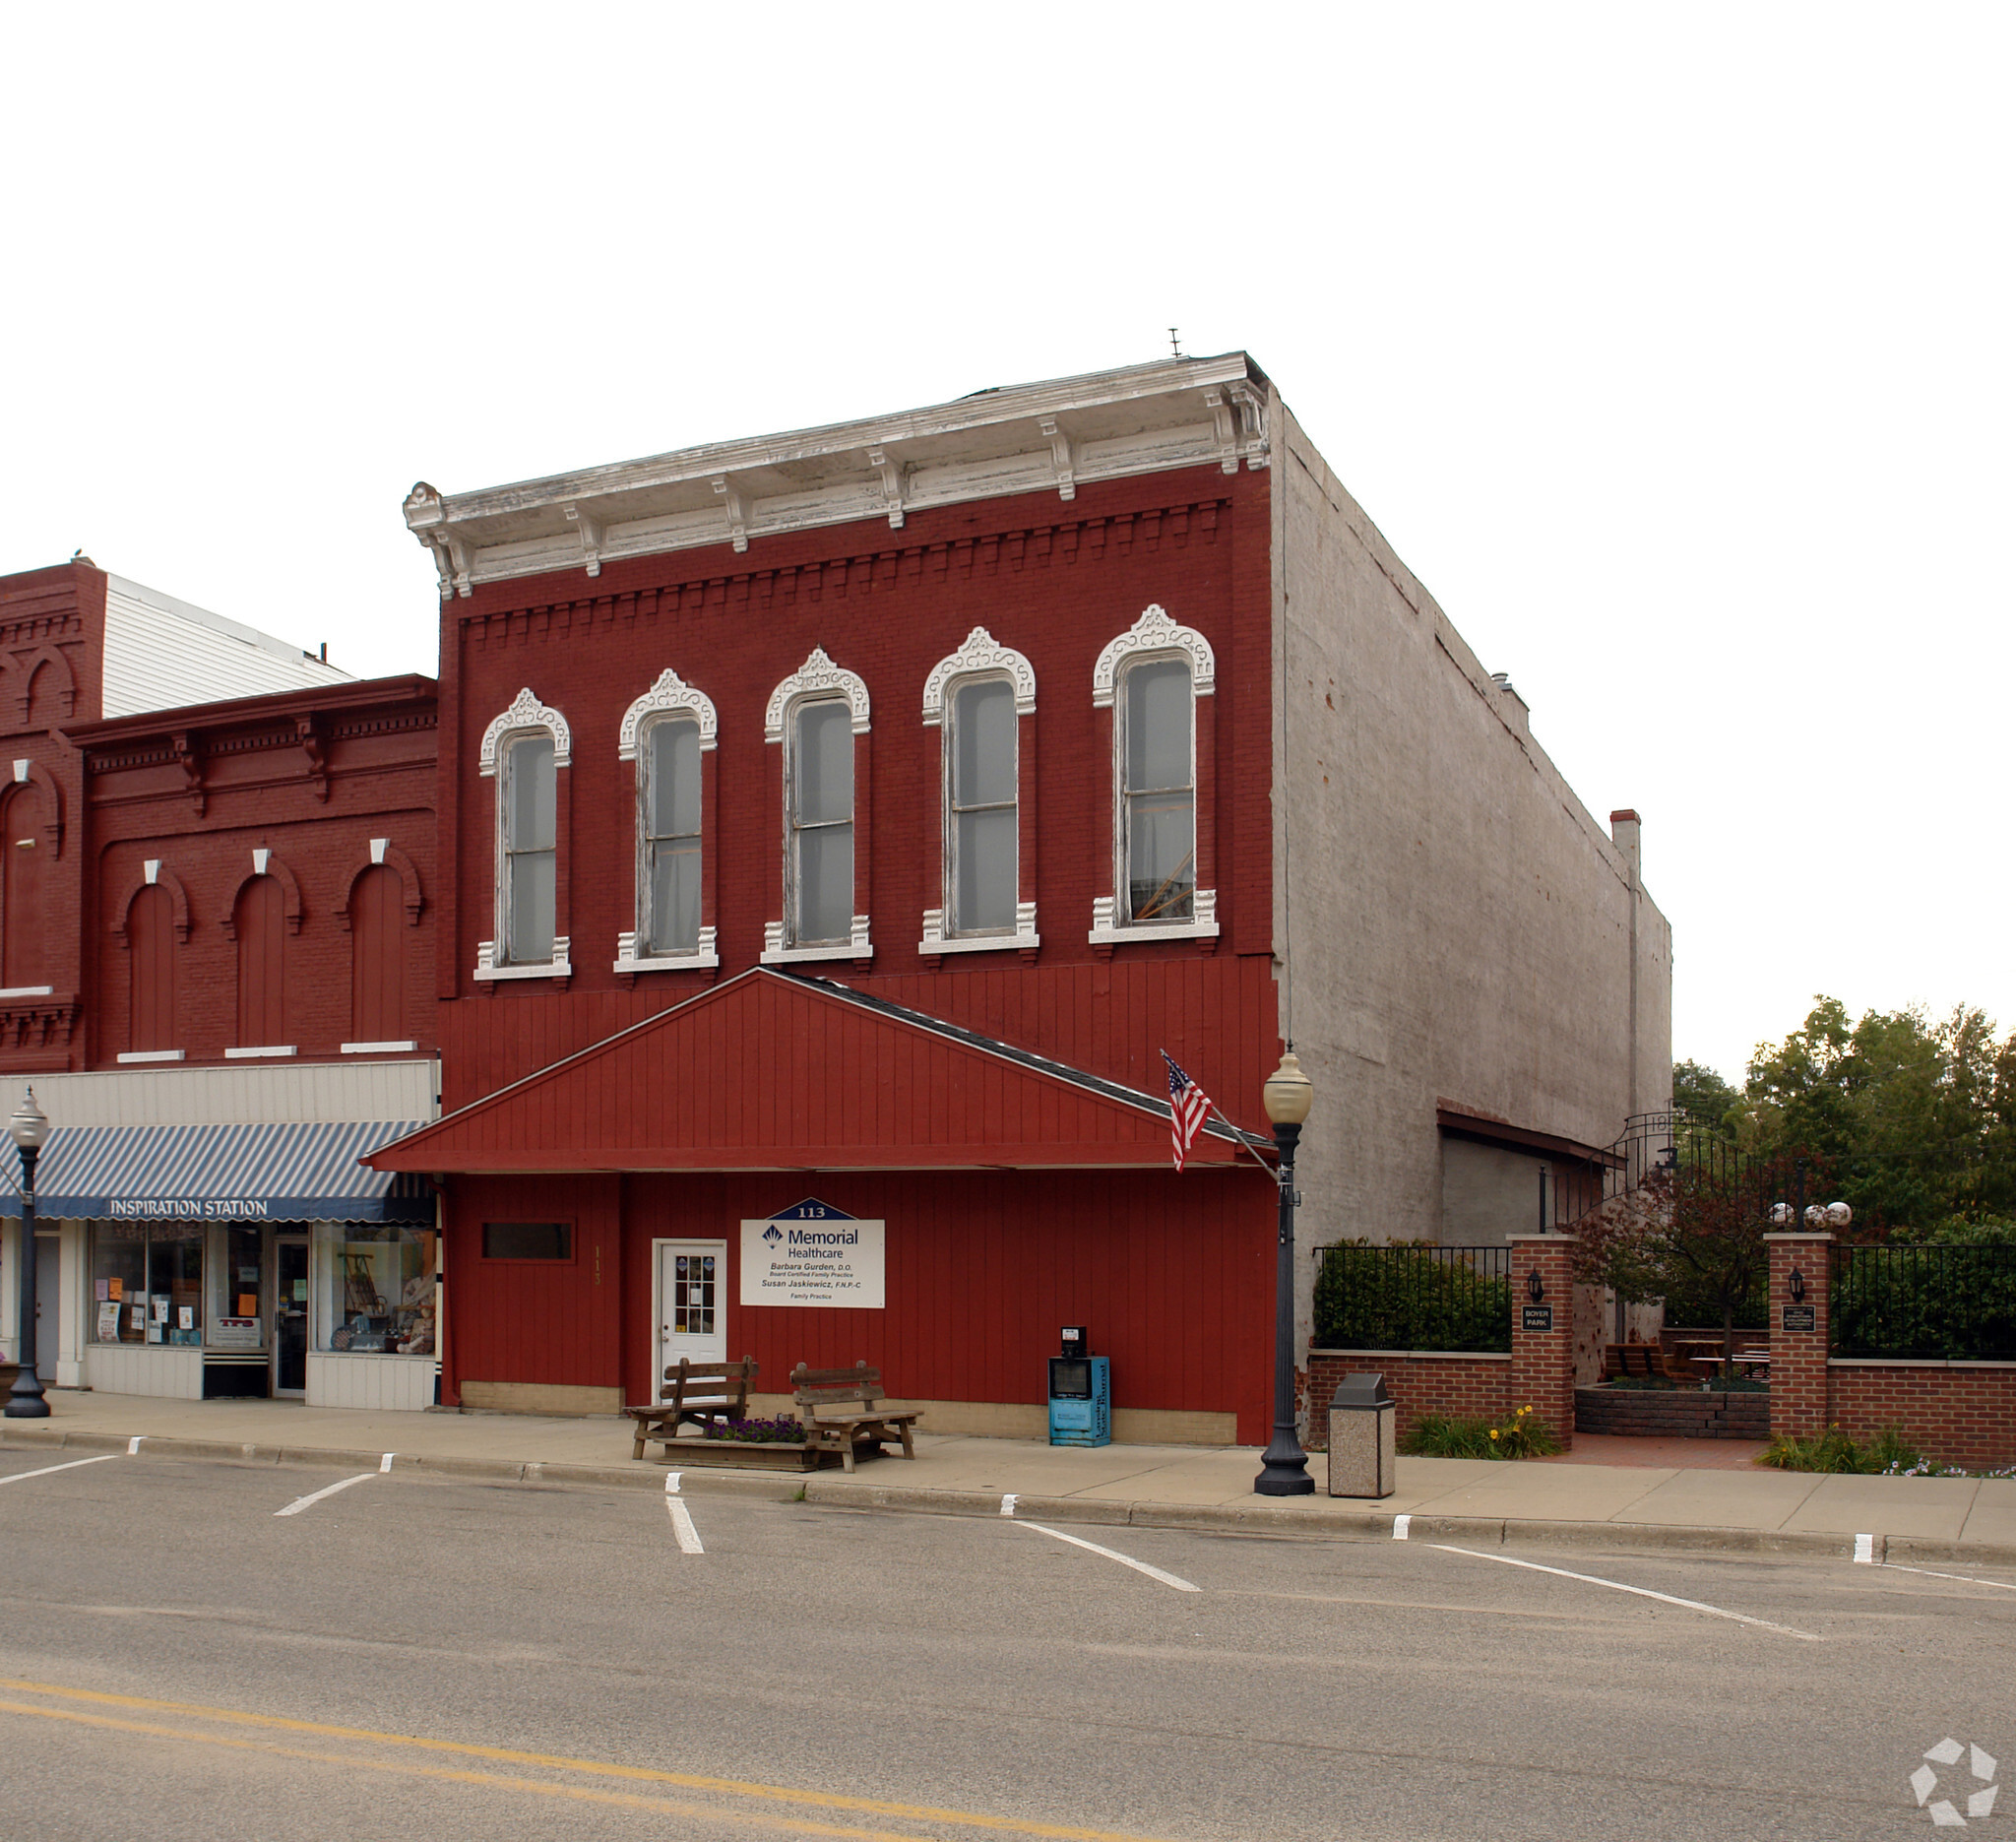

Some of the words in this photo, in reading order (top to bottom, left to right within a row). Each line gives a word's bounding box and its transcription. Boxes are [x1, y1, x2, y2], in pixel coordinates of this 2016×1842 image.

[110, 1200, 201, 1215] INSPIRATION
[205, 1200, 268, 1215] STATION
[798, 1207, 826, 1218] 113
[788, 1229, 858, 1244] Memorial
[788, 1247, 844, 1258] Healthcare
[788, 1280, 834, 1289] Jaskiewicz,
